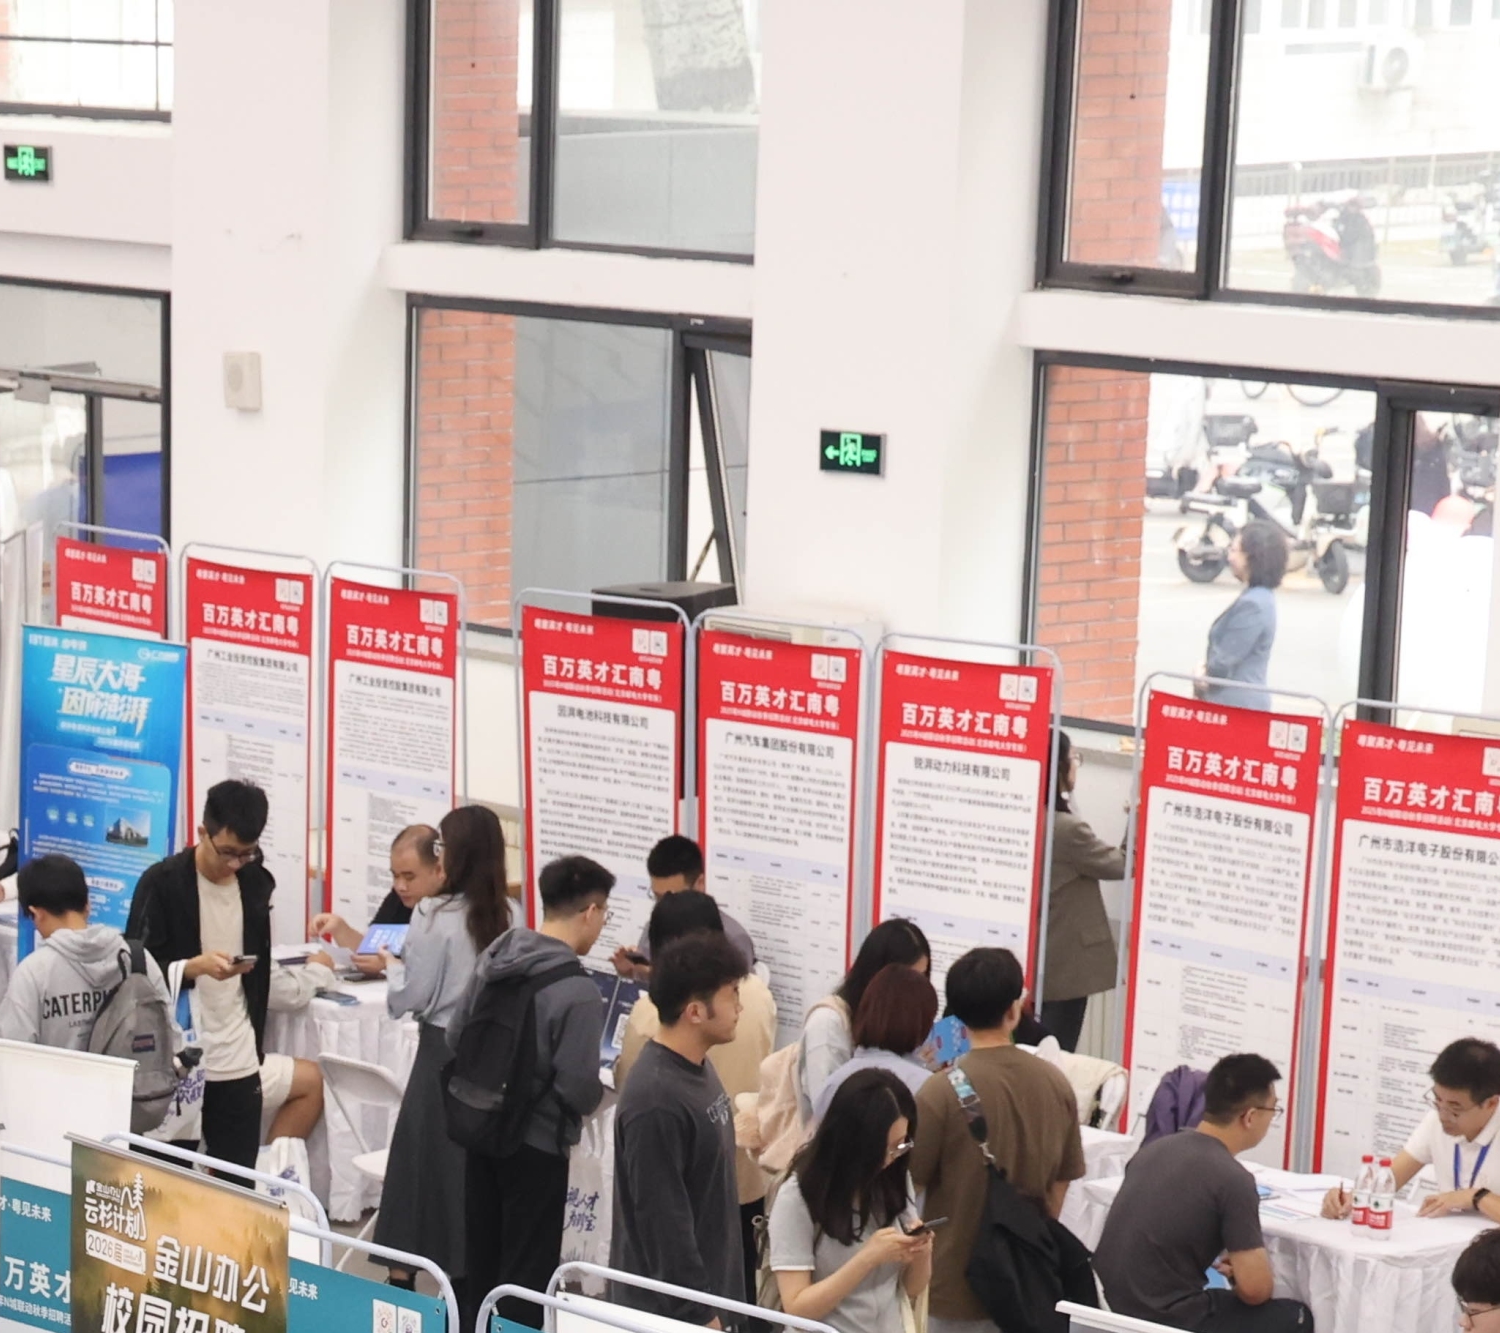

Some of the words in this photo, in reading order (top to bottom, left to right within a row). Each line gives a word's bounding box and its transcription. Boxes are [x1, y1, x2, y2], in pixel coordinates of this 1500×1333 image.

[70, 580, 154, 615] 百万英才汇南粤
[202, 602, 300, 637] 百万英才汇南粤
[346, 623, 444, 659] 百万英才汇南粤
[542, 654, 663, 692] 百万英才汇南粤
[720, 680, 841, 718] 百万英才汇南粤
[900, 703, 1030, 740] 百万英才汇南粤
[724, 731, 835, 760] 广州汽车集团股份有限公司
[1166, 745, 1299, 792] 百万英才汇南粤
[1162, 801, 1294, 838] 广州市浩洋电子股份有限公司
[83, 1198, 141, 1241] 云杉计划
[87, 1233, 123, 1264] 2026届
[152, 1234, 270, 1314] 金山办公
[288, 1276, 319, 1301] 见未来
